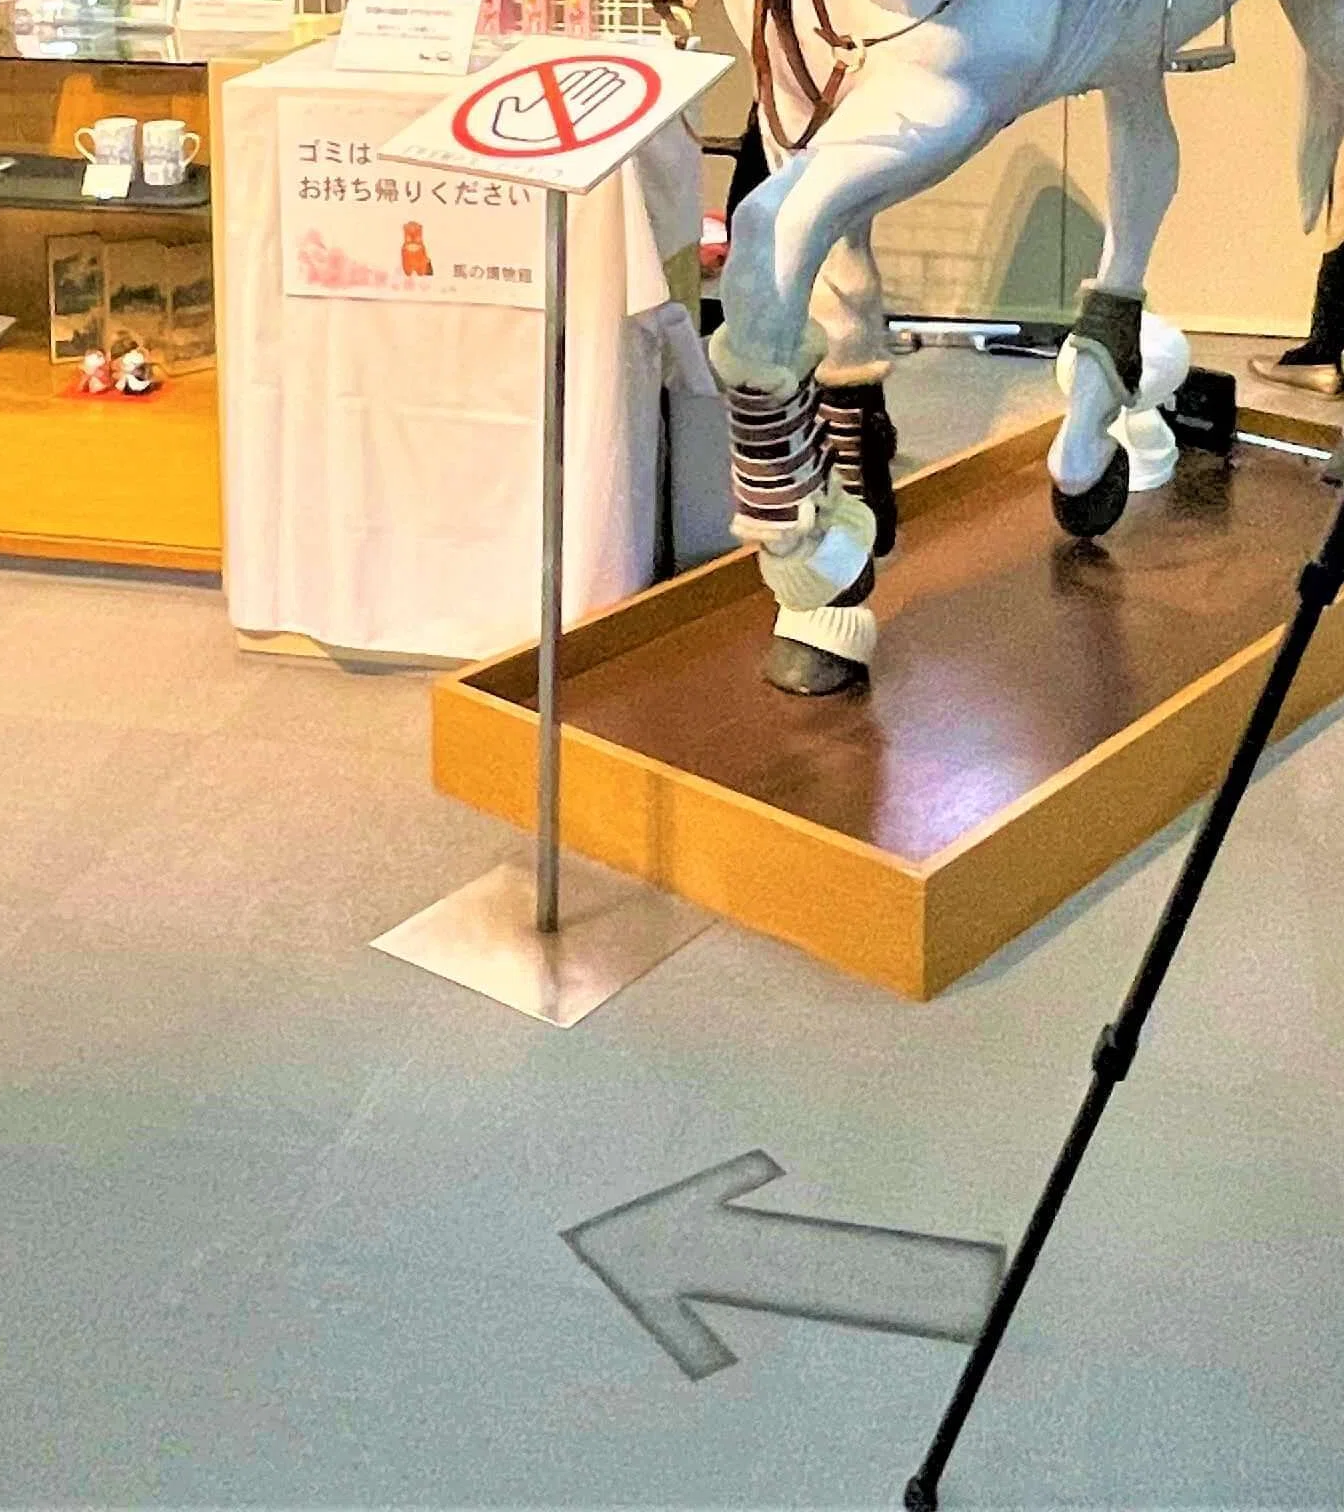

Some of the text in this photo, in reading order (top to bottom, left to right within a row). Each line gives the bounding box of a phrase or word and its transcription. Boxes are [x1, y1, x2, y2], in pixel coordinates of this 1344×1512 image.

[297, 139, 372, 166] ゴミは
[297, 175, 531, 207] お持ち帰りください
